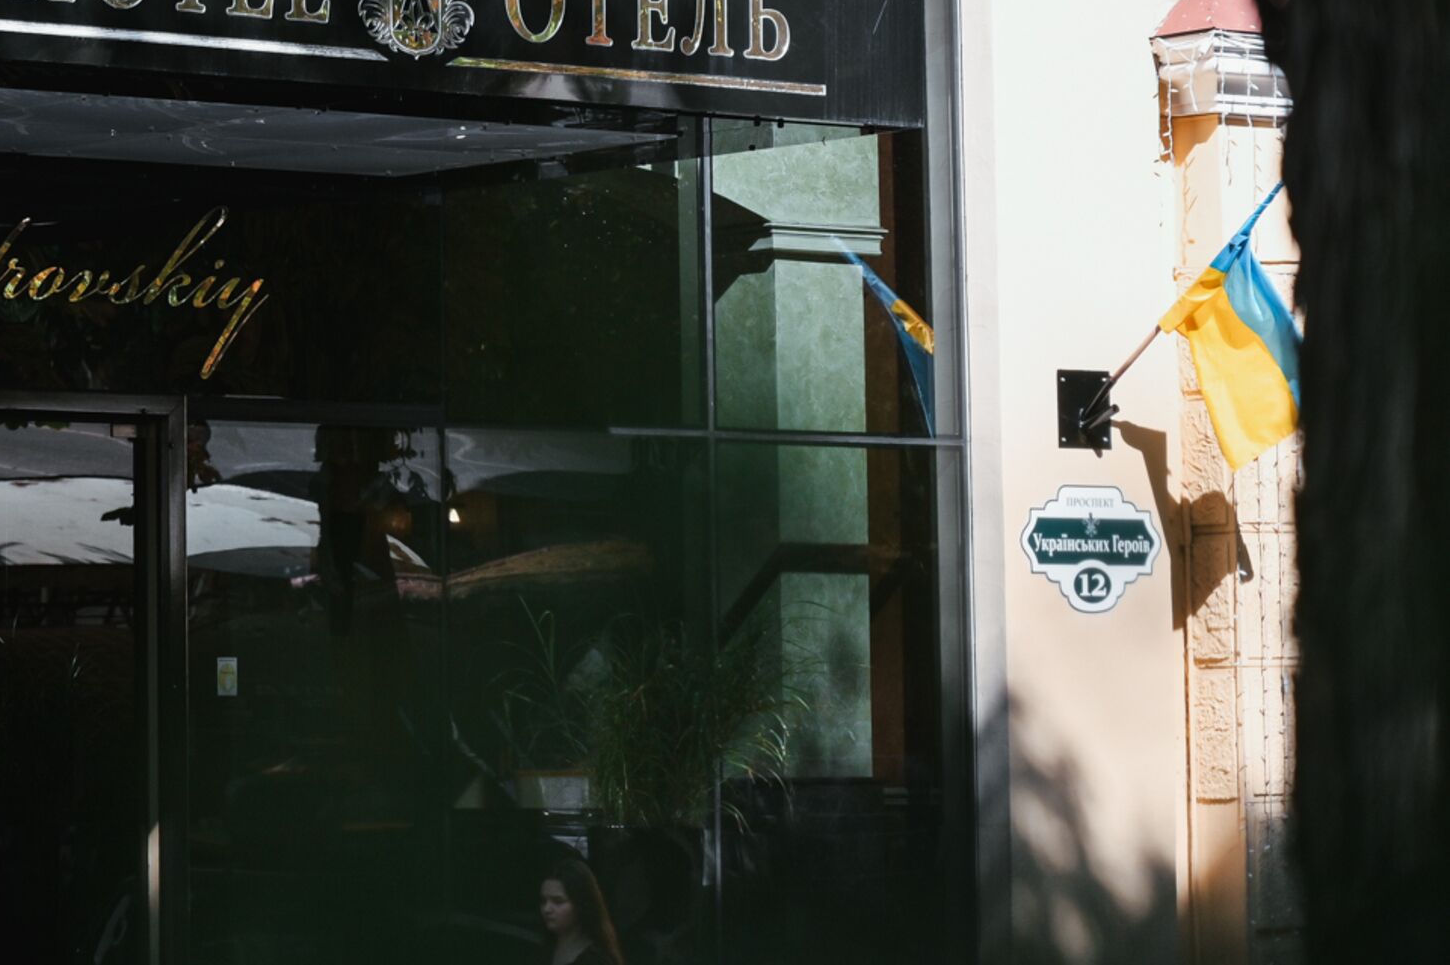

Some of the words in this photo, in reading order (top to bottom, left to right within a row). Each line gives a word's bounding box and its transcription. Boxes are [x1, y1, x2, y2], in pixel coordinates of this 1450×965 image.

[1066, 497, 1114, 508] ПРОСПЕКТ
[1033, 533, 1110, 556] Українських
[1112, 534, 1150, 557] Героїв
[1079, 573, 1107, 597] 12
